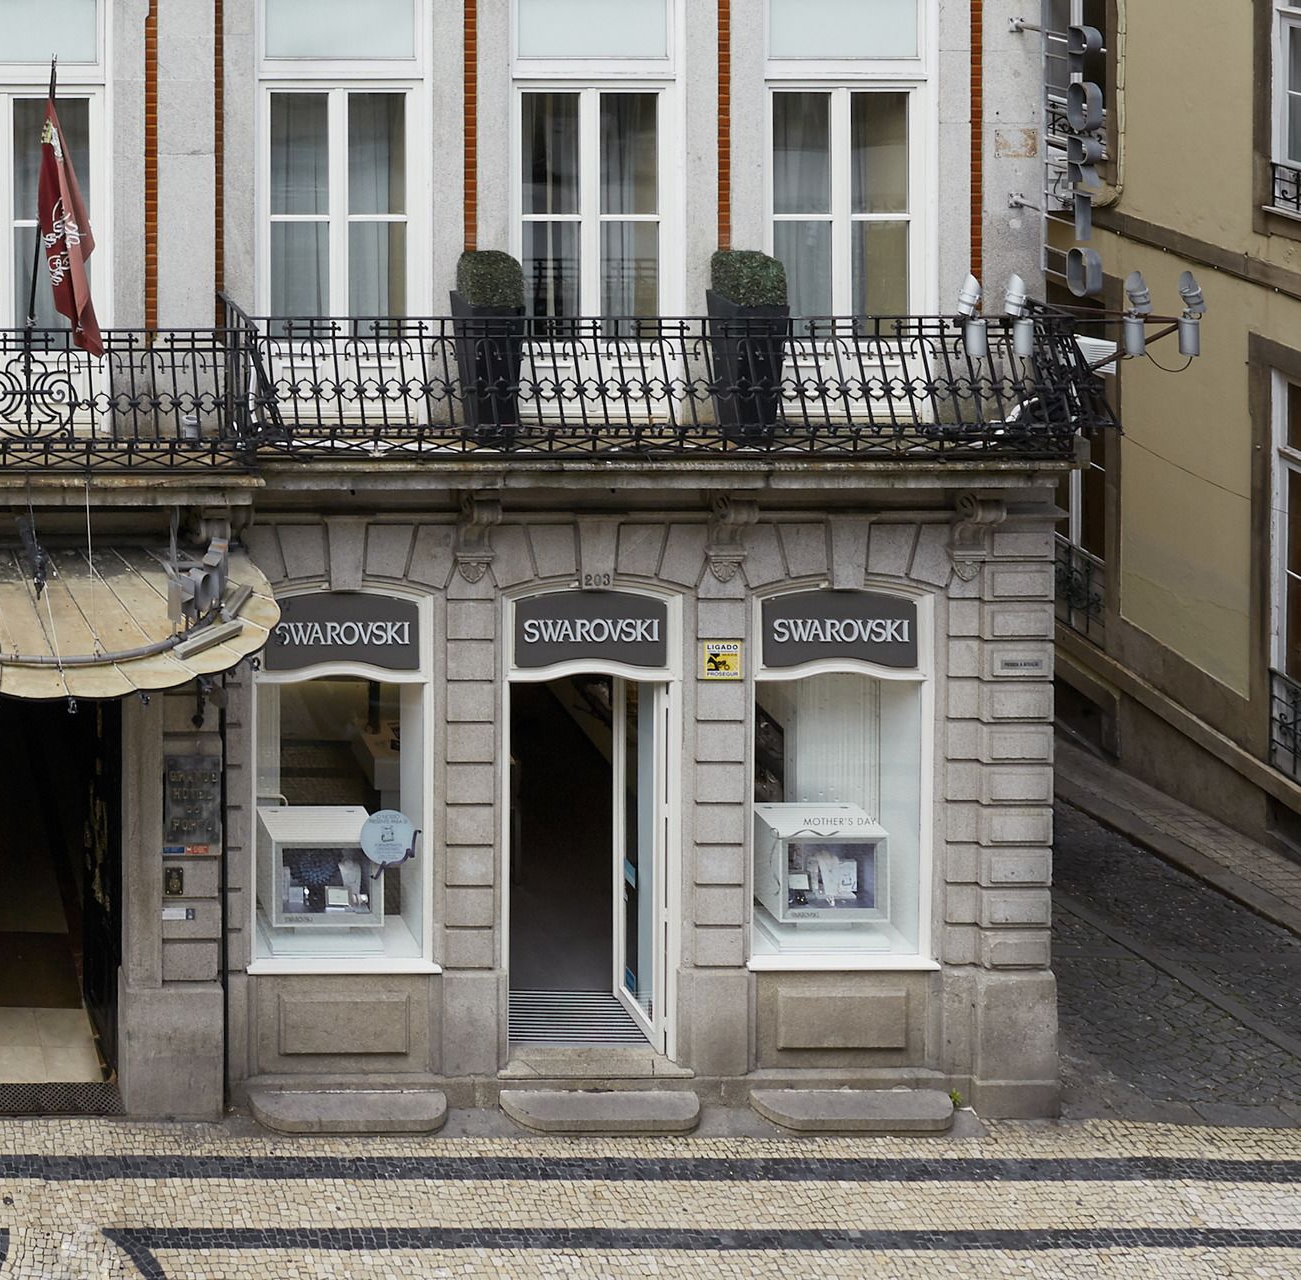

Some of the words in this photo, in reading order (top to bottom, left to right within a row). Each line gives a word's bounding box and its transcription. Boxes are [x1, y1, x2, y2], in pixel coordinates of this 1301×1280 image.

[584, 573, 611, 587] 203
[275, 621, 411, 645] SWAROVSKI
[524, 618, 660, 643] SWAROVSKI
[773, 618, 910, 642] SWAROVSKI
[803, 817, 854, 826] MOTHER'S
[857, 817, 877, 826] DAY
